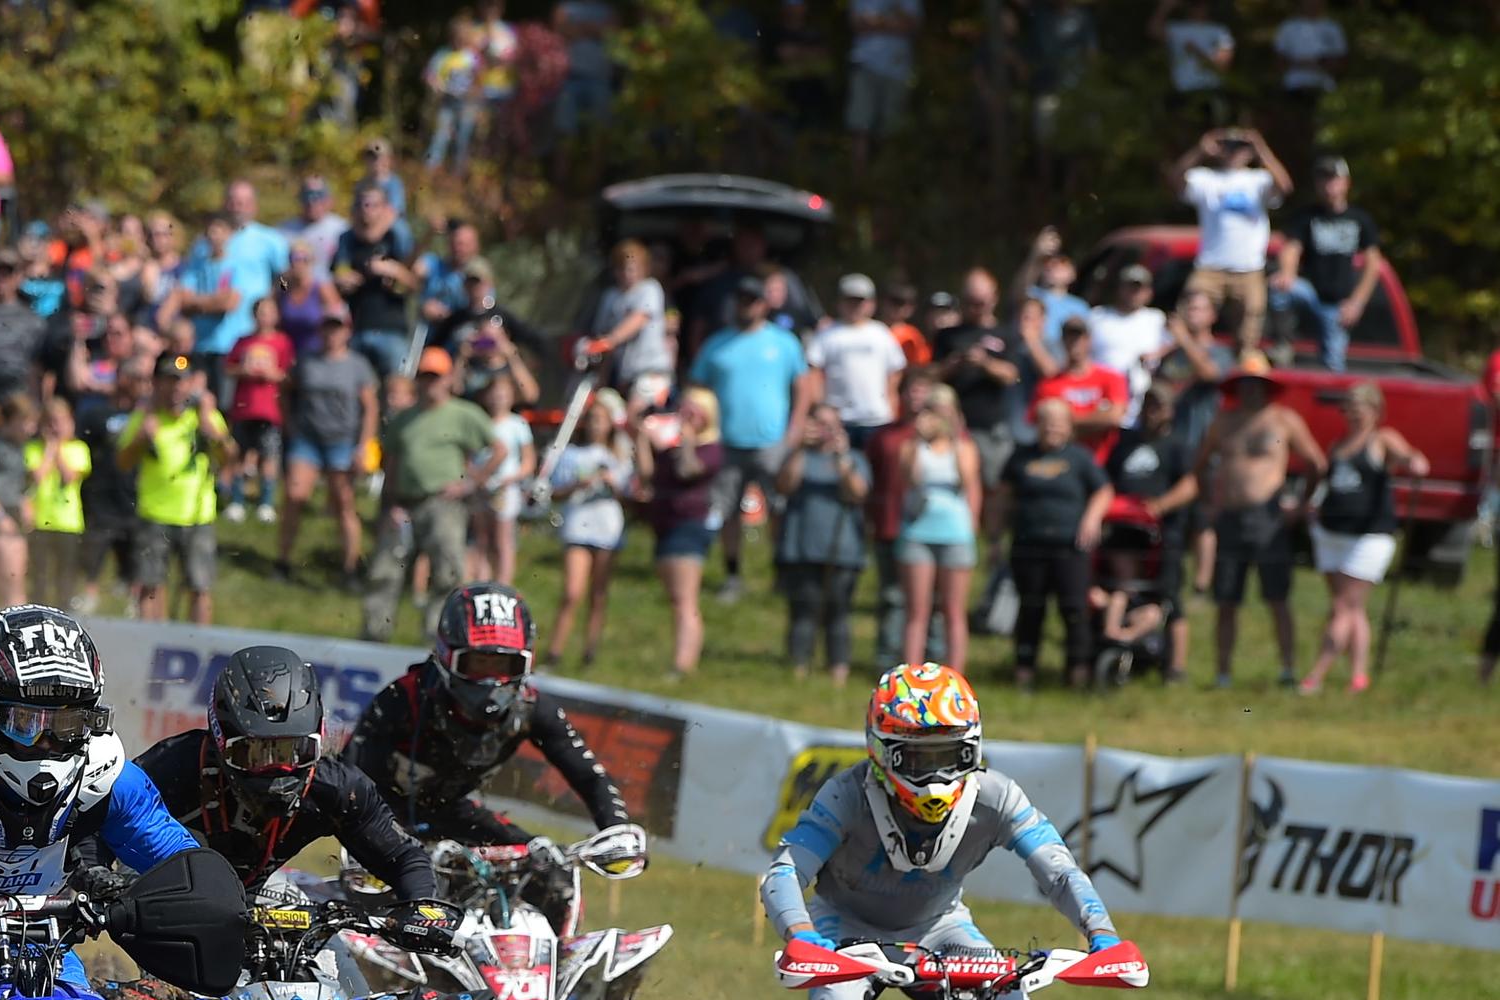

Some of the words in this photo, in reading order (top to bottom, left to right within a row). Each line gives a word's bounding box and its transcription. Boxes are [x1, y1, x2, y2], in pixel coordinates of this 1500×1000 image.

[473, 593, 517, 619] FLY
[20, 620, 79, 650] FLY
[1271, 825, 1415, 904] THOR
[785, 961, 840, 973] ACERBIS
[923, 962, 1009, 974] RENTHAL
